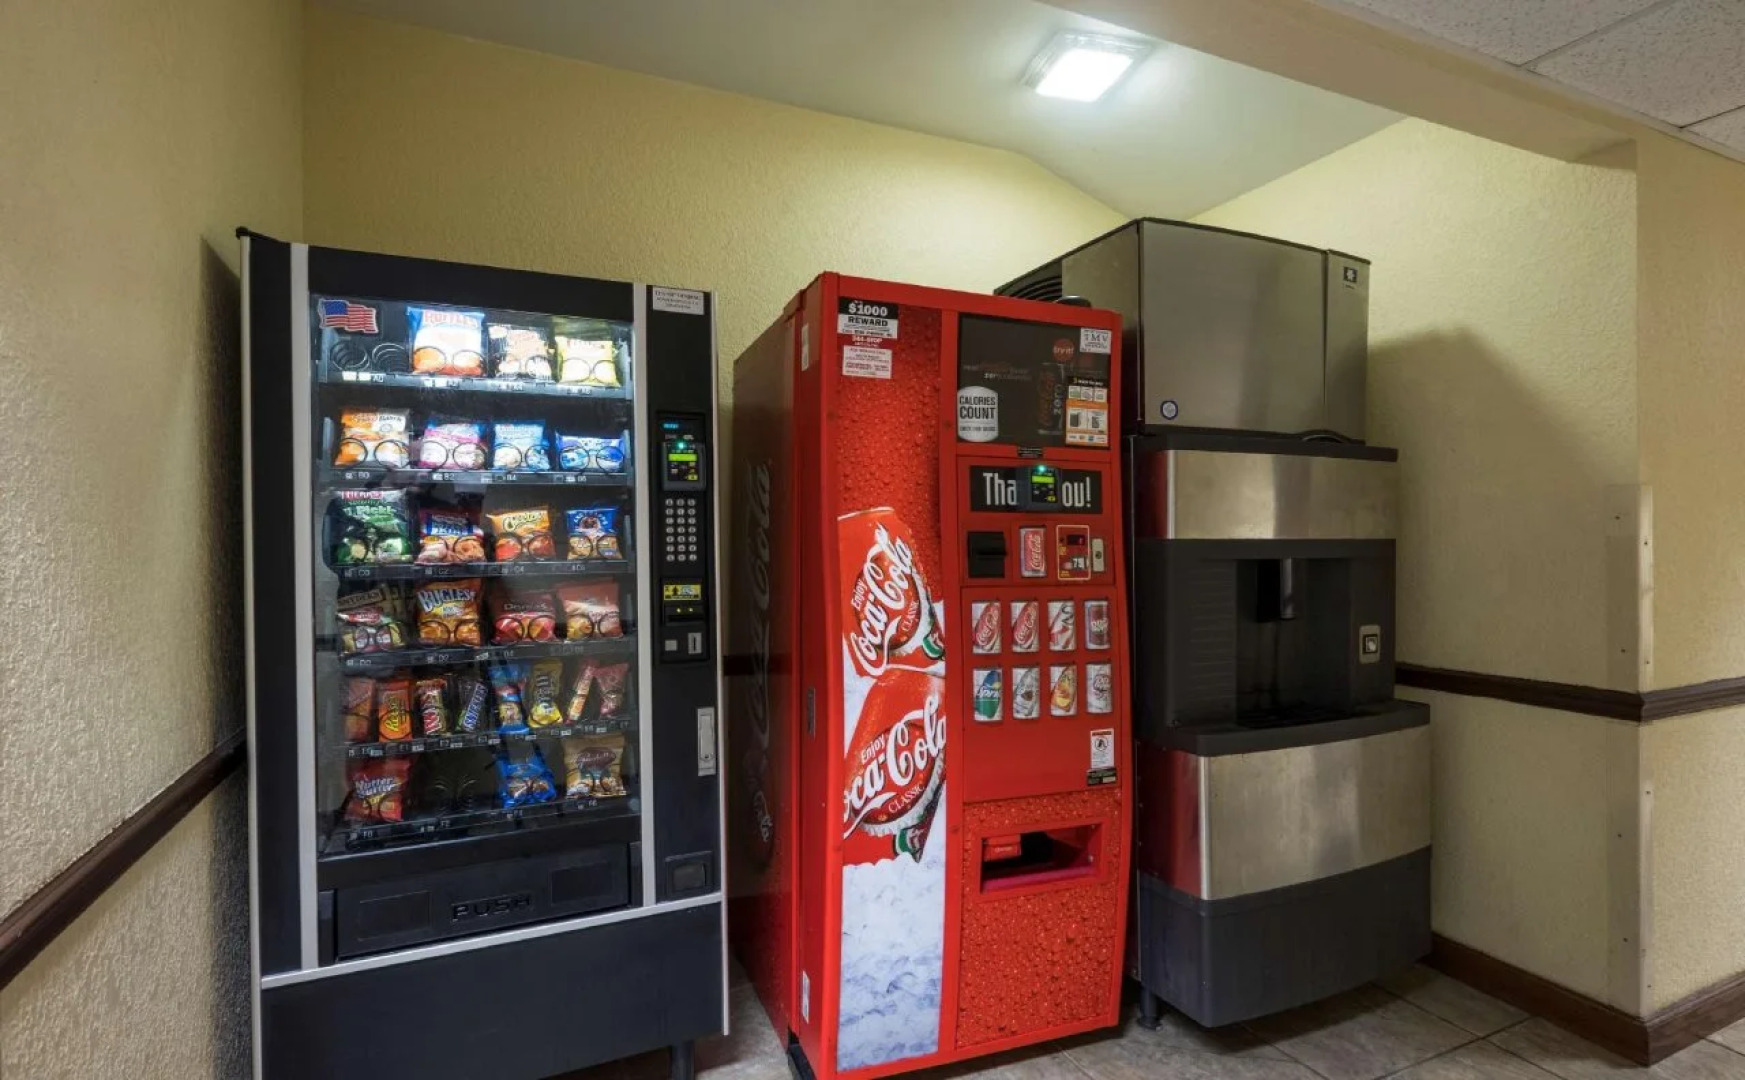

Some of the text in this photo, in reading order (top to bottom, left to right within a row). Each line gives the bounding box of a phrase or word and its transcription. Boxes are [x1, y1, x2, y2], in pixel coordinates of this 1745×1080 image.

[848, 302, 888, 316] $1000
[848, 316, 888, 326] REWARD
[959, 396, 996, 406] CALORIES
[959, 406, 996, 420] COUNT
[982, 472, 1092, 508] Tha ou!
[416, 588, 477, 613] BUGLES
[850, 578, 868, 612] Enjoy
[850, 521, 913, 676] Coca-Cola
[861, 733, 886, 764] Enjoy
[888, 783, 925, 814] CLASSIC
[451, 894, 531, 922] PUSH
